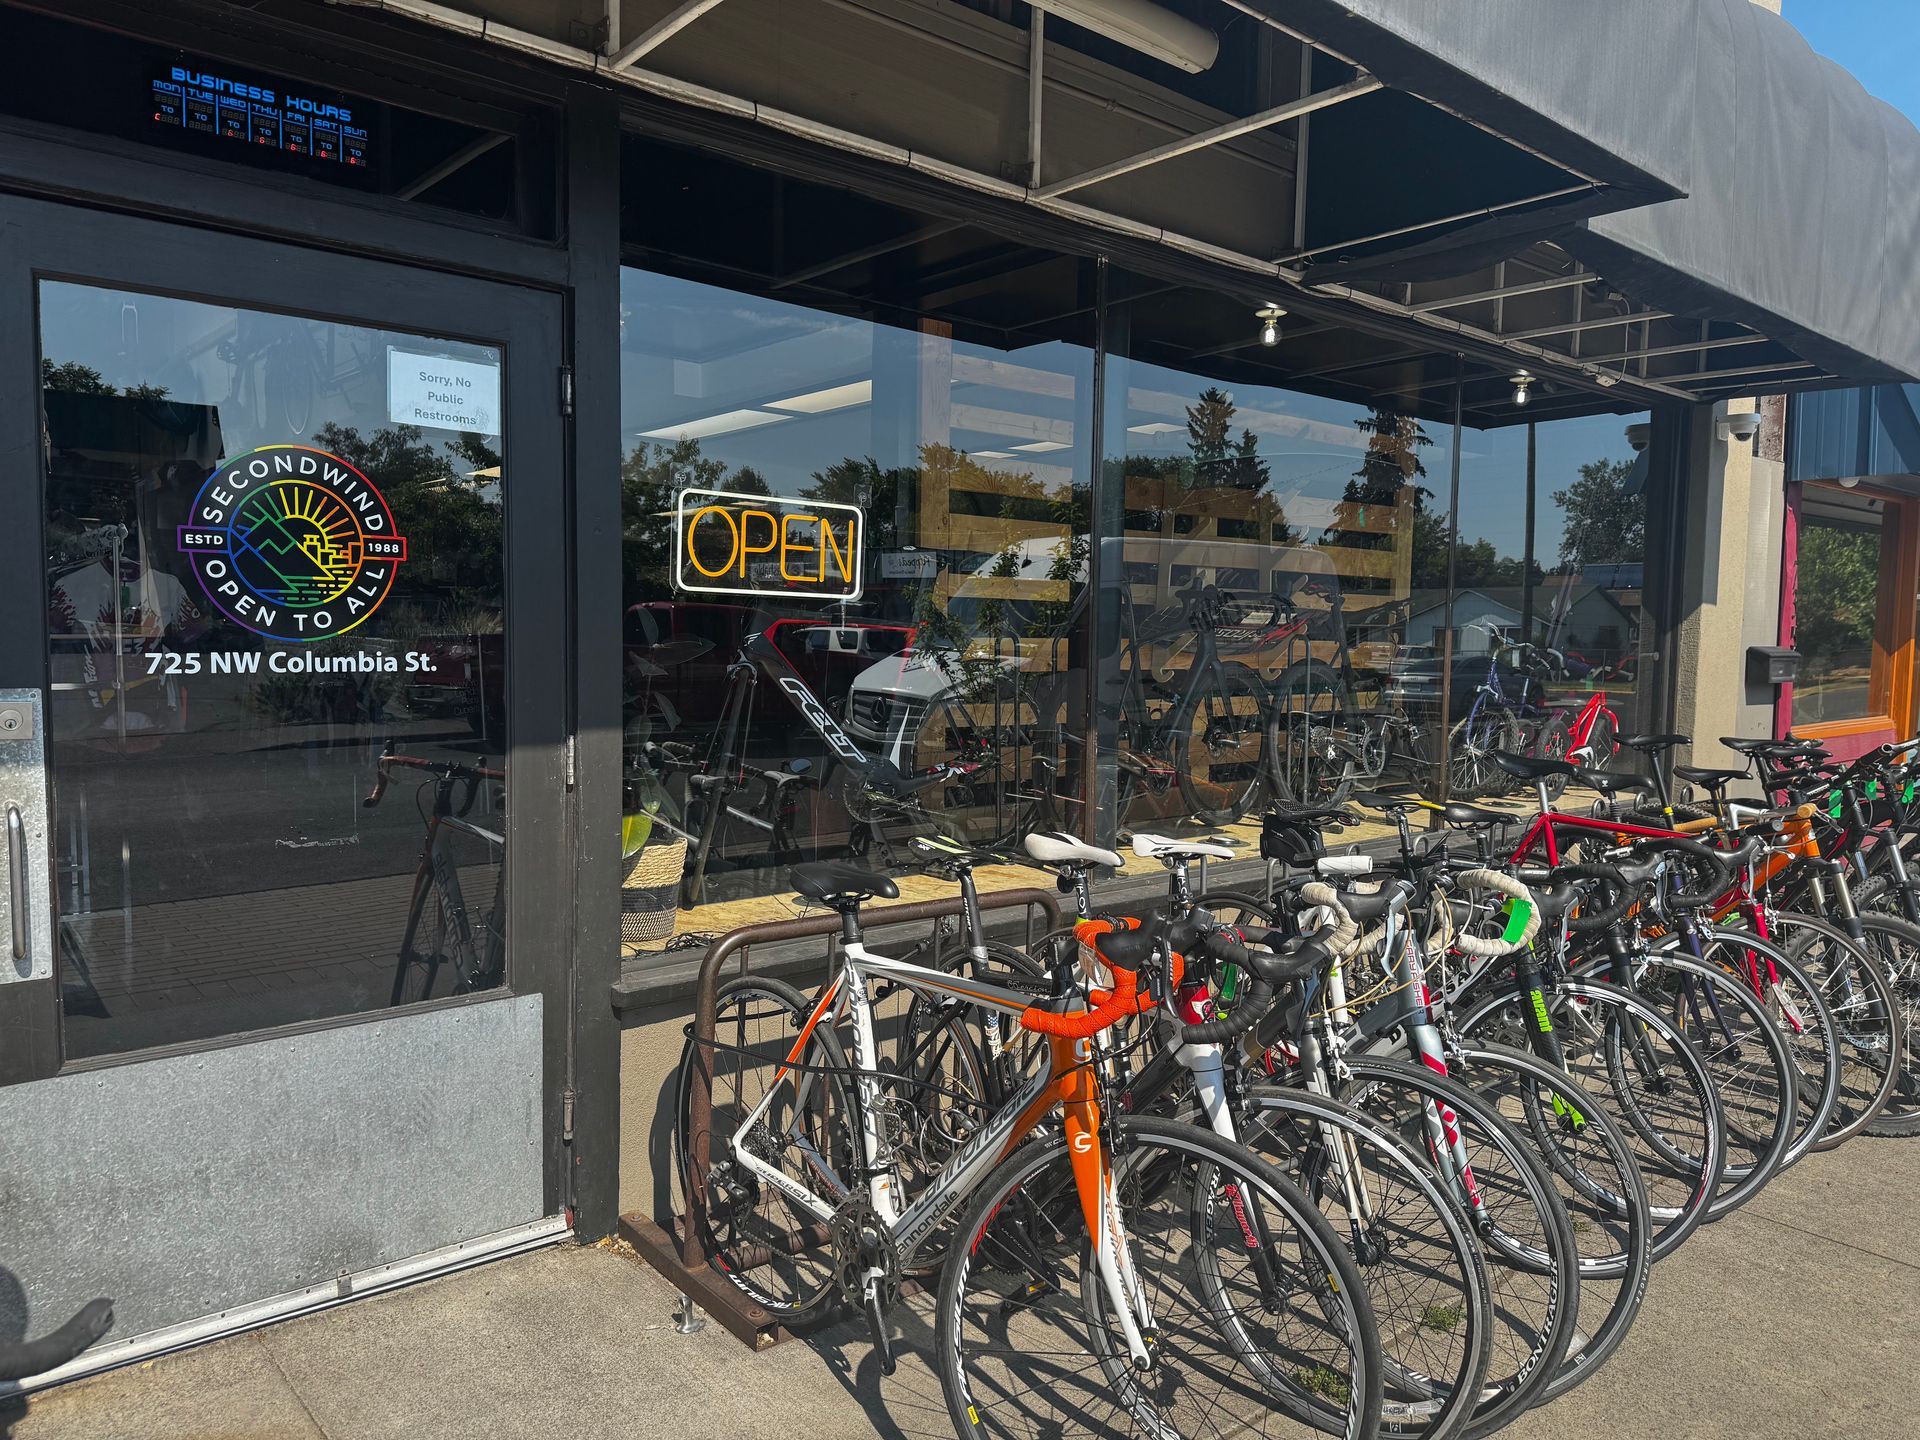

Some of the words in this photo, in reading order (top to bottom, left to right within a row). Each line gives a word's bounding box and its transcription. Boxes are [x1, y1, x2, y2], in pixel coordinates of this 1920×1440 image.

[171, 67, 275, 103] BUSINESS
[286, 95, 352, 122] HOURS
[187, 88, 215, 101] TUE
[220, 95, 247, 109] WED
[252, 103, 278, 116] THU
[286, 111, 306, 123] FRI
[314, 118, 338, 130] SAT
[161, 104, 175, 114] TO
[194, 112, 208, 122] TO
[227, 119, 240, 129] TO
[259, 127, 272, 136] TO
[290, 134, 303, 143] TO
[320, 141, 333, 150] TO
[350, 148, 362, 157] TO
[419, 371, 453, 387] Sorry,
[455, 377, 472, 388] No
[427, 391, 464, 405] Public
[414, 408, 477, 425] Restrooms
[202, 455, 384, 531] SECONDWIND
[185, 534, 224, 546] ESTD
[367, 542, 400, 554] 1988
[687, 505, 855, 584] OPEN
[205, 559, 277, 627] OPEN
[293, 610, 333, 631] TO
[346, 567, 385, 615] ALL
[143, 652, 202, 675] 725
[210, 651, 262, 674] NW
[268, 650, 399, 674] Columbia
[404, 651, 438, 672] St.
[1344, 1110, 1434, 1180] SECA
[896, 1189, 961, 1256] annondale
[1634, 1237, 1652, 1304] BONTRAGER
[954, 1256, 973, 1405] AKSIUM
[1517, 1256, 1559, 1386] BONTRAGER
